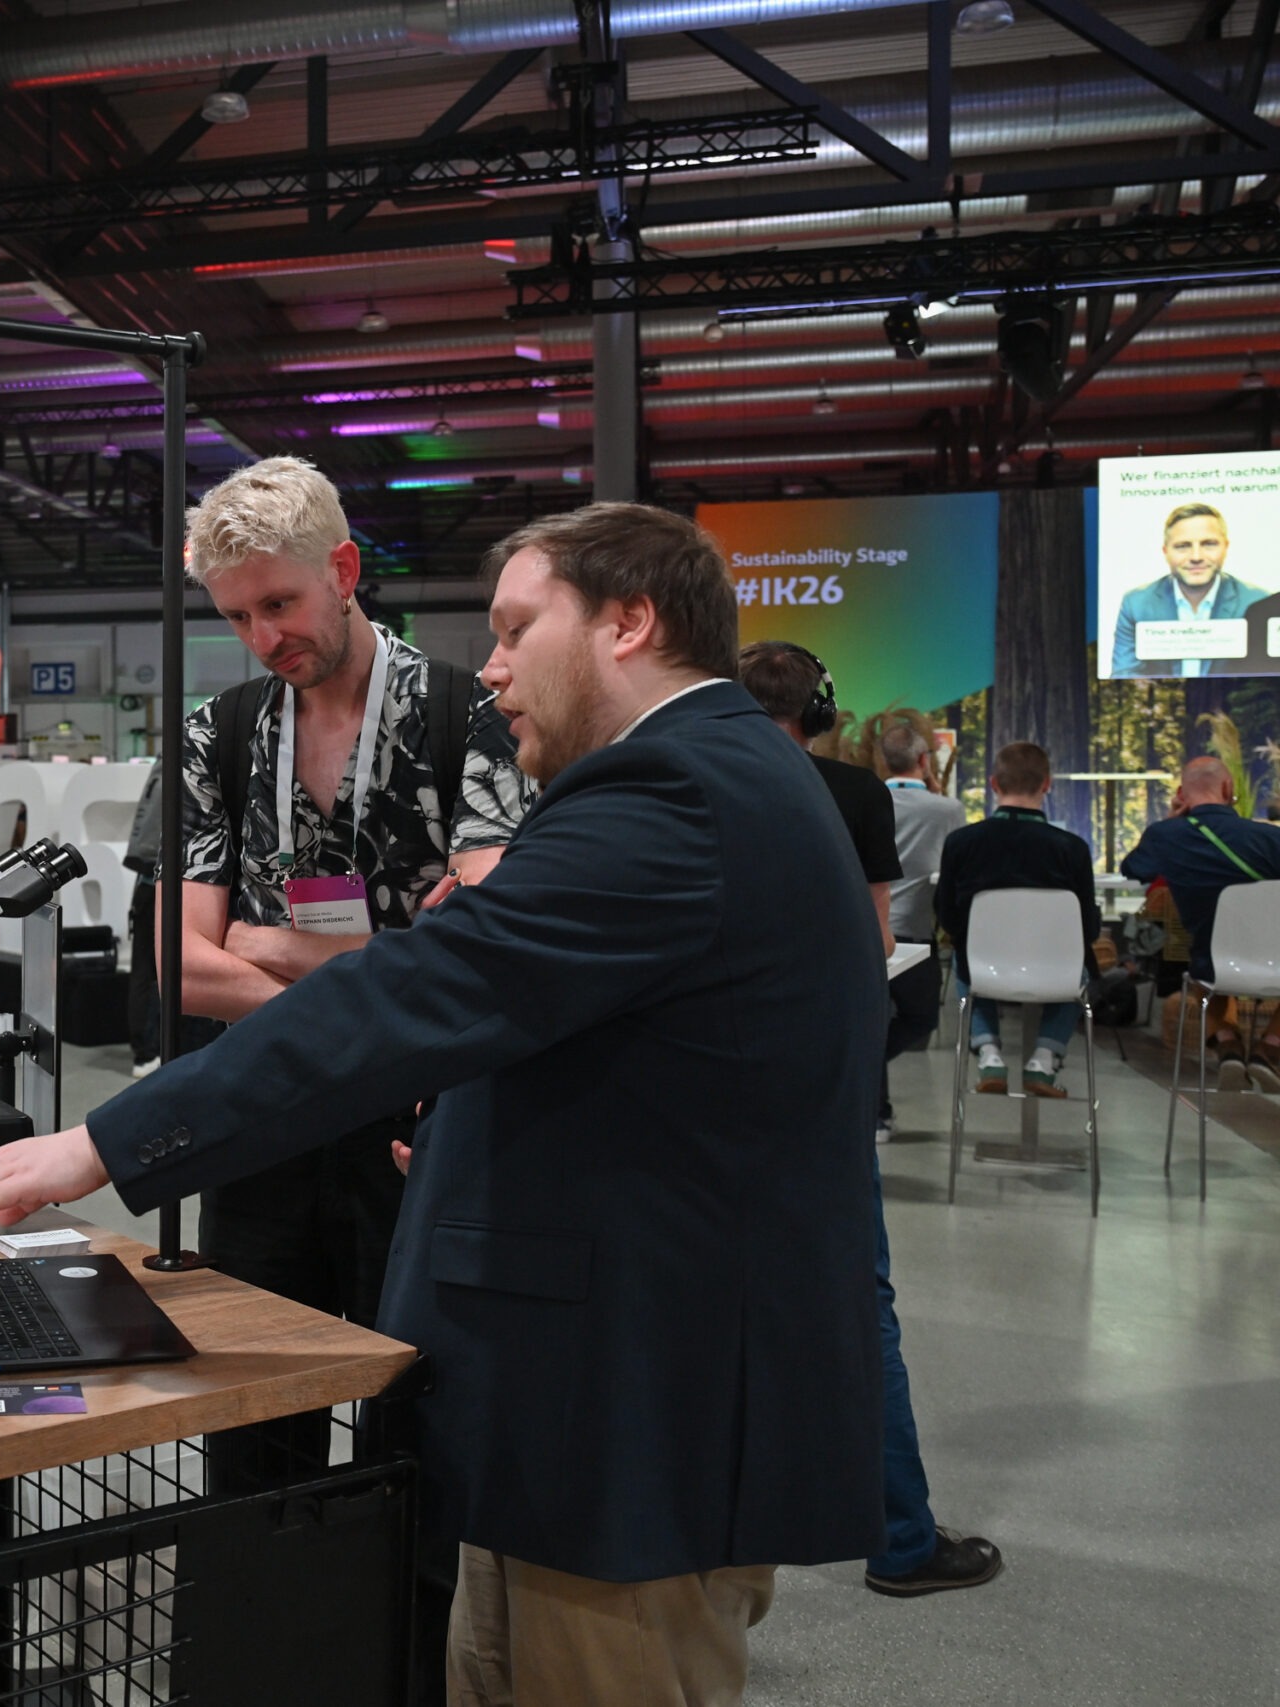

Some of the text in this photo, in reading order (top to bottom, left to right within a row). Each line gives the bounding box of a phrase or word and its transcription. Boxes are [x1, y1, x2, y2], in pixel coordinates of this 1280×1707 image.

[1120, 472, 1148, 482] Wer
[1153, 469, 1221, 480] finanziert
[1120, 483, 1279, 497] Innovation und warum
[731, 547, 908, 568] Sustainability Stage
[734, 575, 844, 607] #IK26
[58, 667, 73, 691] 5
